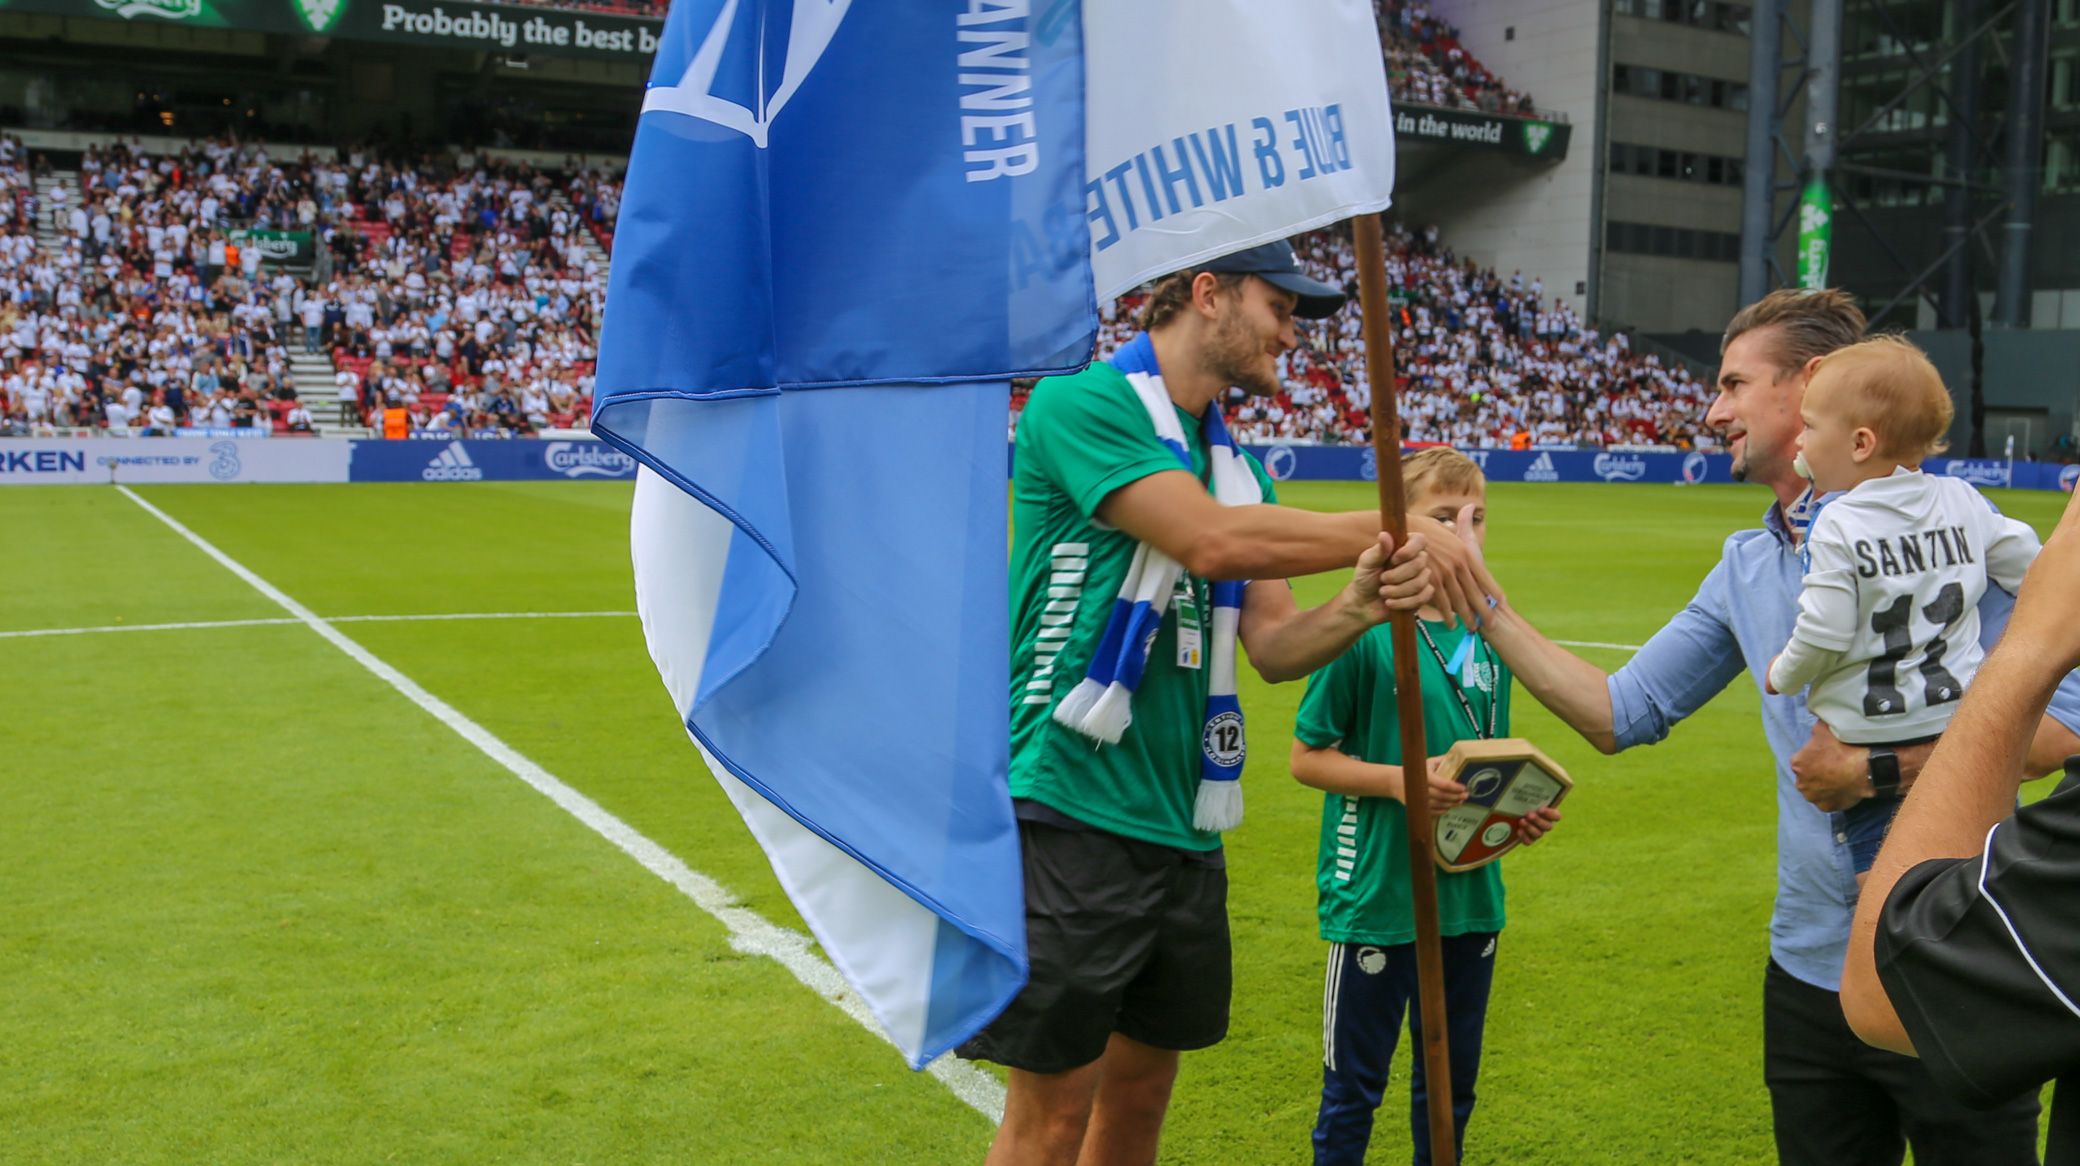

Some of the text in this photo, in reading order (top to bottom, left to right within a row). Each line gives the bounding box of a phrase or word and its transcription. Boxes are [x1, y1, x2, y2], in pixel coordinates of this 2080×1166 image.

[381, 4, 517, 47] Probably
[523, 16, 570, 46] the
[575, 20, 633, 52] best
[956, 0, 1039, 183] ANNER
[1397, 111, 1502, 144] in the world
[0, 452, 84, 472] KEN
[182, 456, 201, 466] BY
[422, 467, 482, 480] adidas
[545, 442, 635, 478] Carlsberg
[1593, 453, 1646, 480] Carlsberg
[1862, 581, 1965, 717] 11
[1215, 725, 1240, 752] 12
